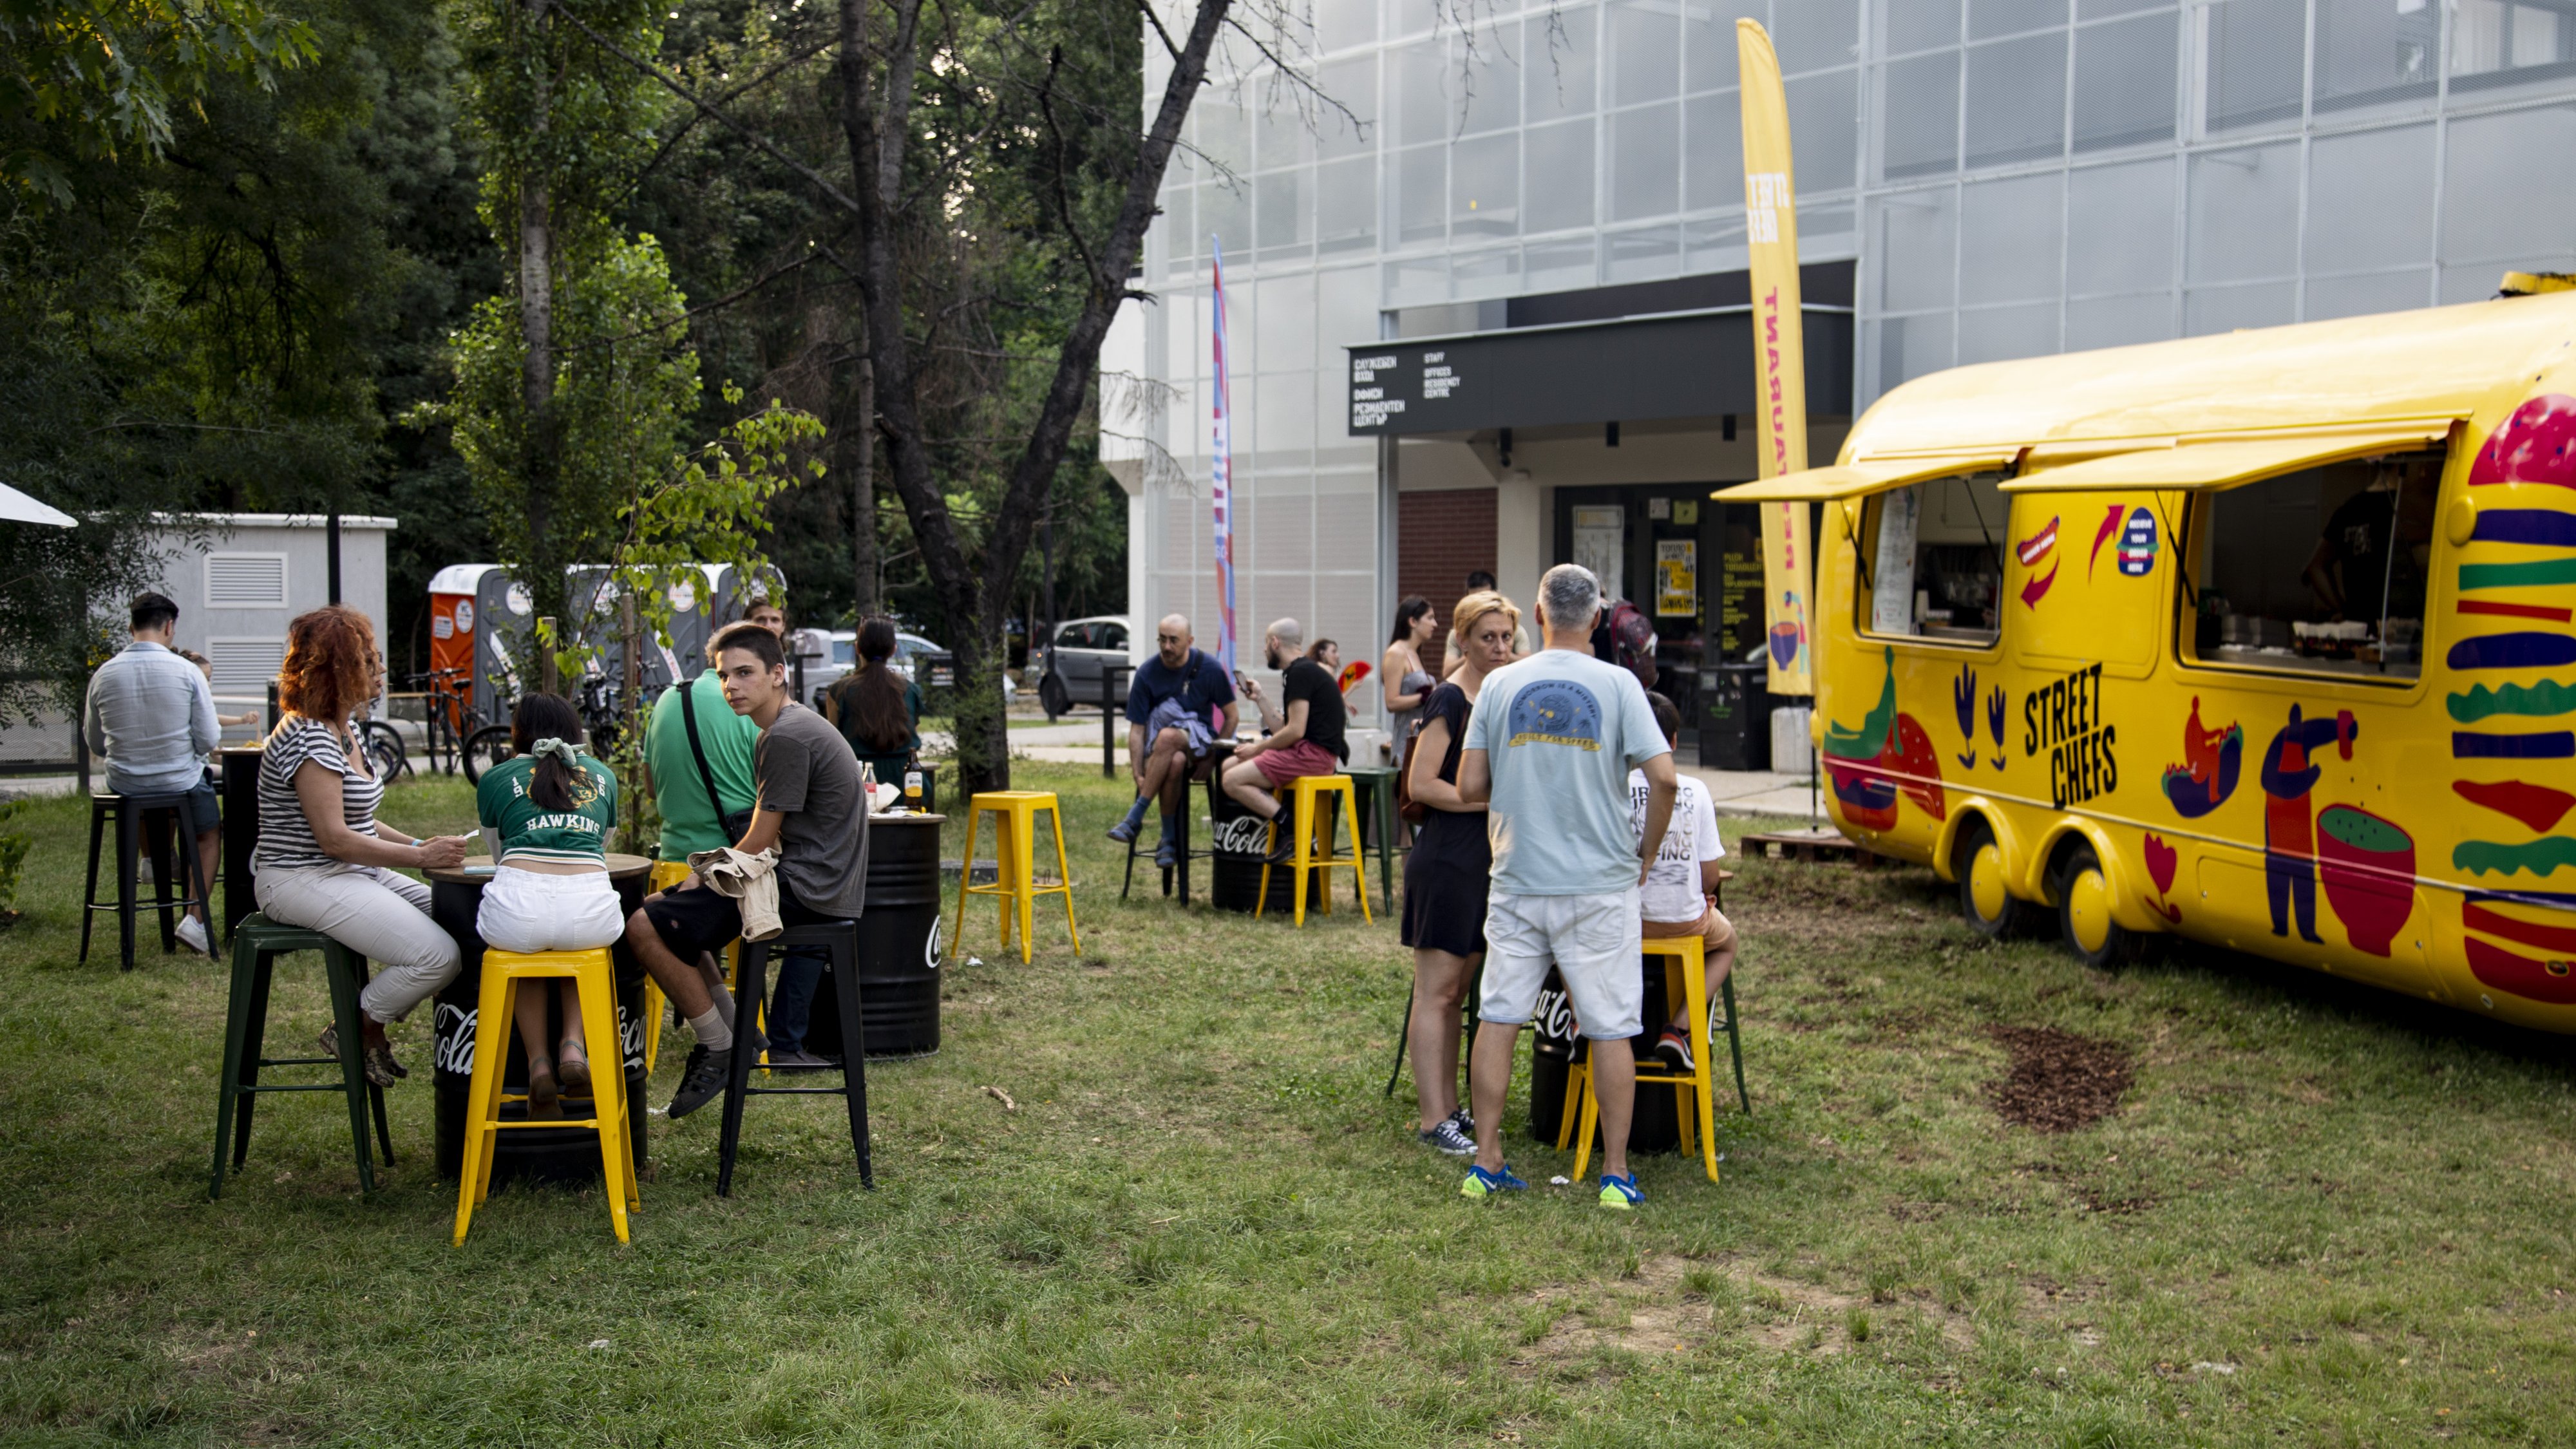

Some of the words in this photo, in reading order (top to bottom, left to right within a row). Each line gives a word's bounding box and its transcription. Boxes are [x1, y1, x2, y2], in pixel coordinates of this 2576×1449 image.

[1424, 352, 1444, 363] STAFF
[1423, 366, 1452, 378] OFFICES
[1423, 377, 1461, 389] RESIDENCY
[1354, 387, 1383, 401] ОФИСИ
[1354, 399, 1405, 414] РЕЗИДЕНТЕН
[1354, 413, 1387, 428] ЦЕНТЪР
[2131, 534, 2147, 544] YOUR
[1515, 683, 1555, 710] TOMORROW
[2024, 662, 2102, 757] STREET
[2052, 725, 2117, 811] CHEFS
[526, 814, 600, 835] HAWKINS
